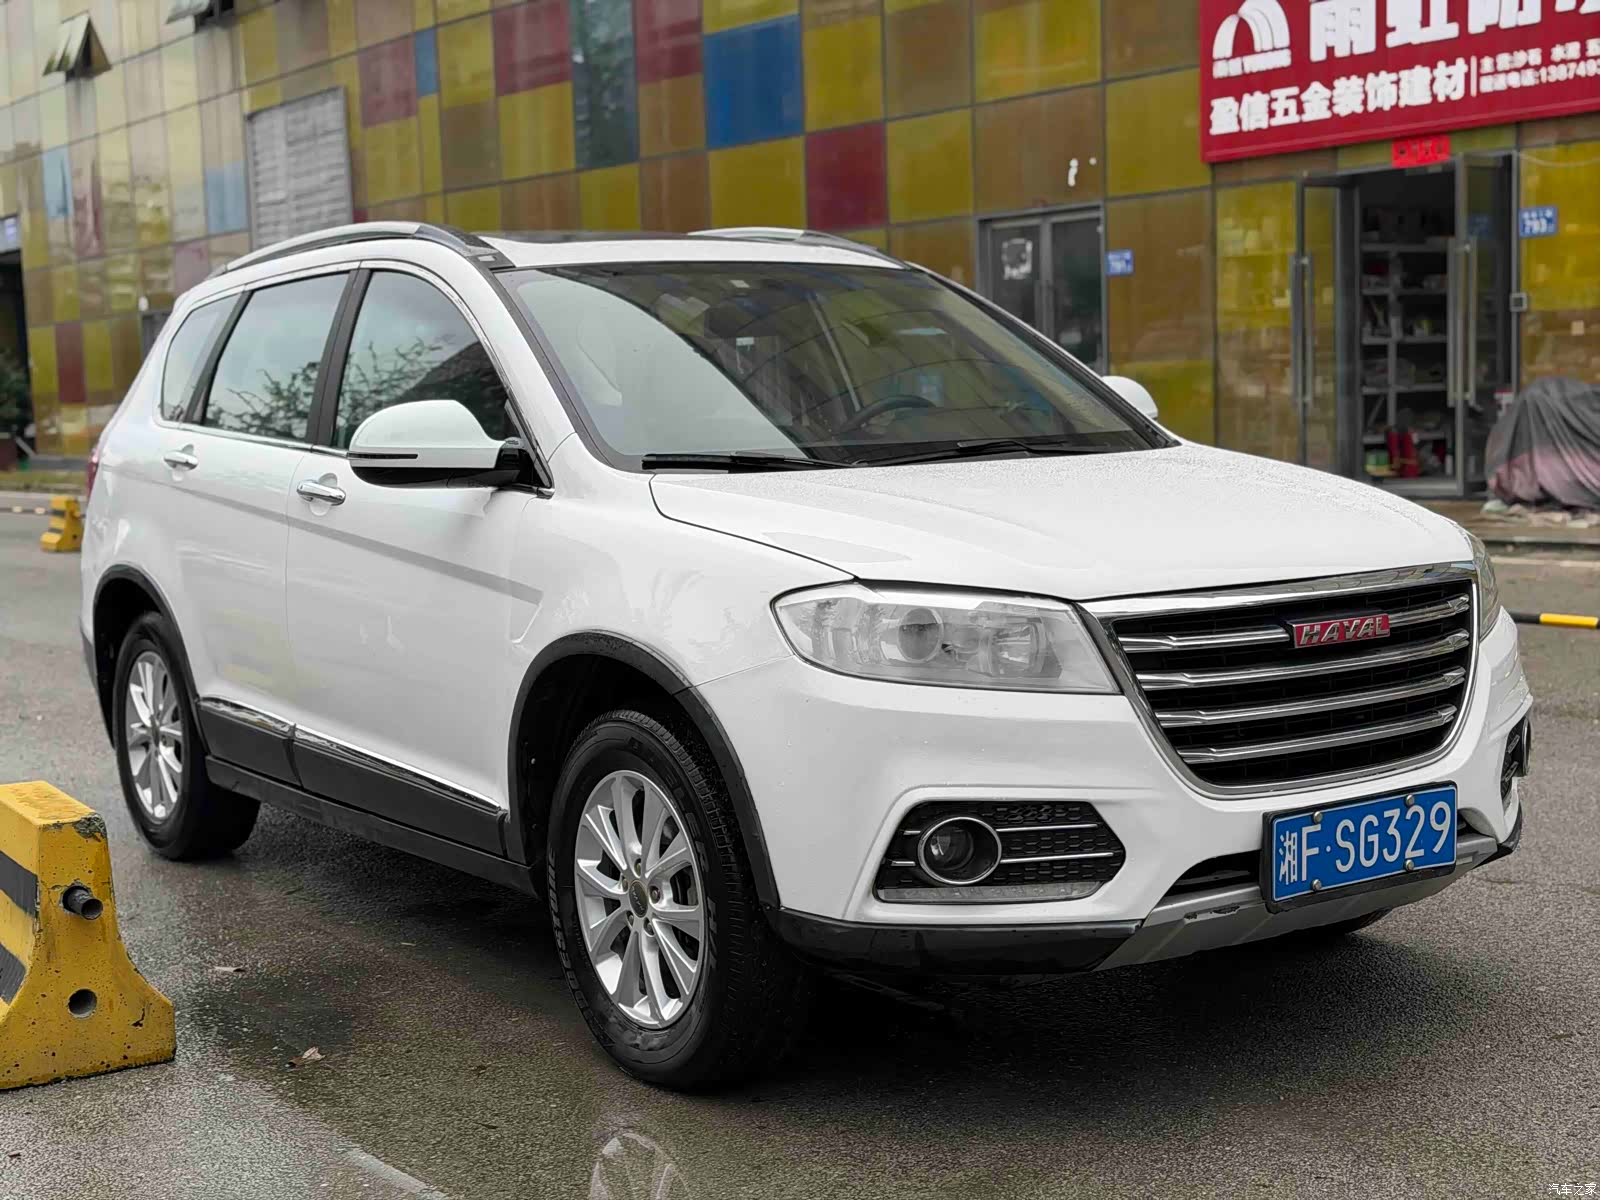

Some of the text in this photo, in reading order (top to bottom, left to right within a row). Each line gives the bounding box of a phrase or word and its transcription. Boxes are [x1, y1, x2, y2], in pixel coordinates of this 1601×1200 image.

[1310, 0, 1601, 62] 雨虹
[1209, 56, 1468, 135] 盈信五金装饰建材
[1299, 616, 1390, 645] HAVAL
